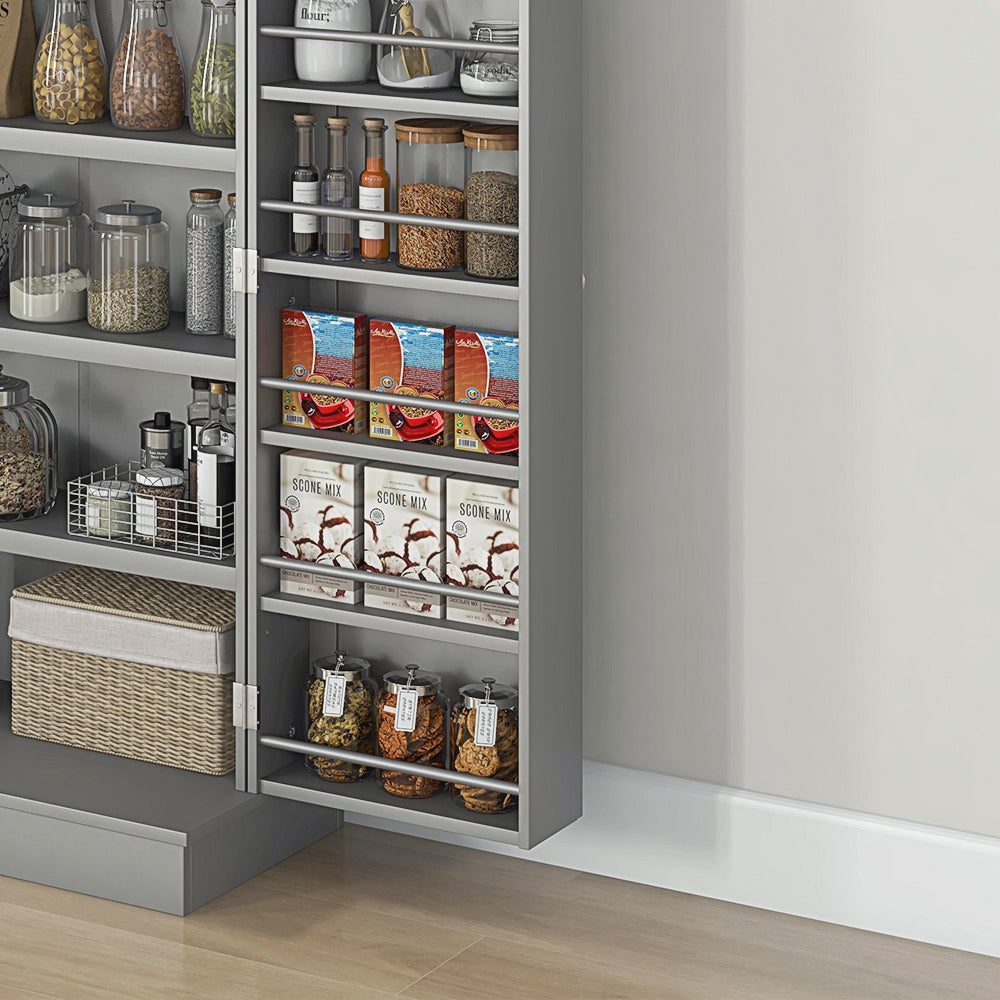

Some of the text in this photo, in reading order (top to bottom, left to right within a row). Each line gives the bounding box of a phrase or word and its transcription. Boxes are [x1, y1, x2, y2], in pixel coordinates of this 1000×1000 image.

[301, 7, 330, 23] flour;
[292, 477, 342, 498] SCONE MIX
[377, 490, 428, 510] SCONE MIX
[459, 502, 511, 523] SCONE MIX
